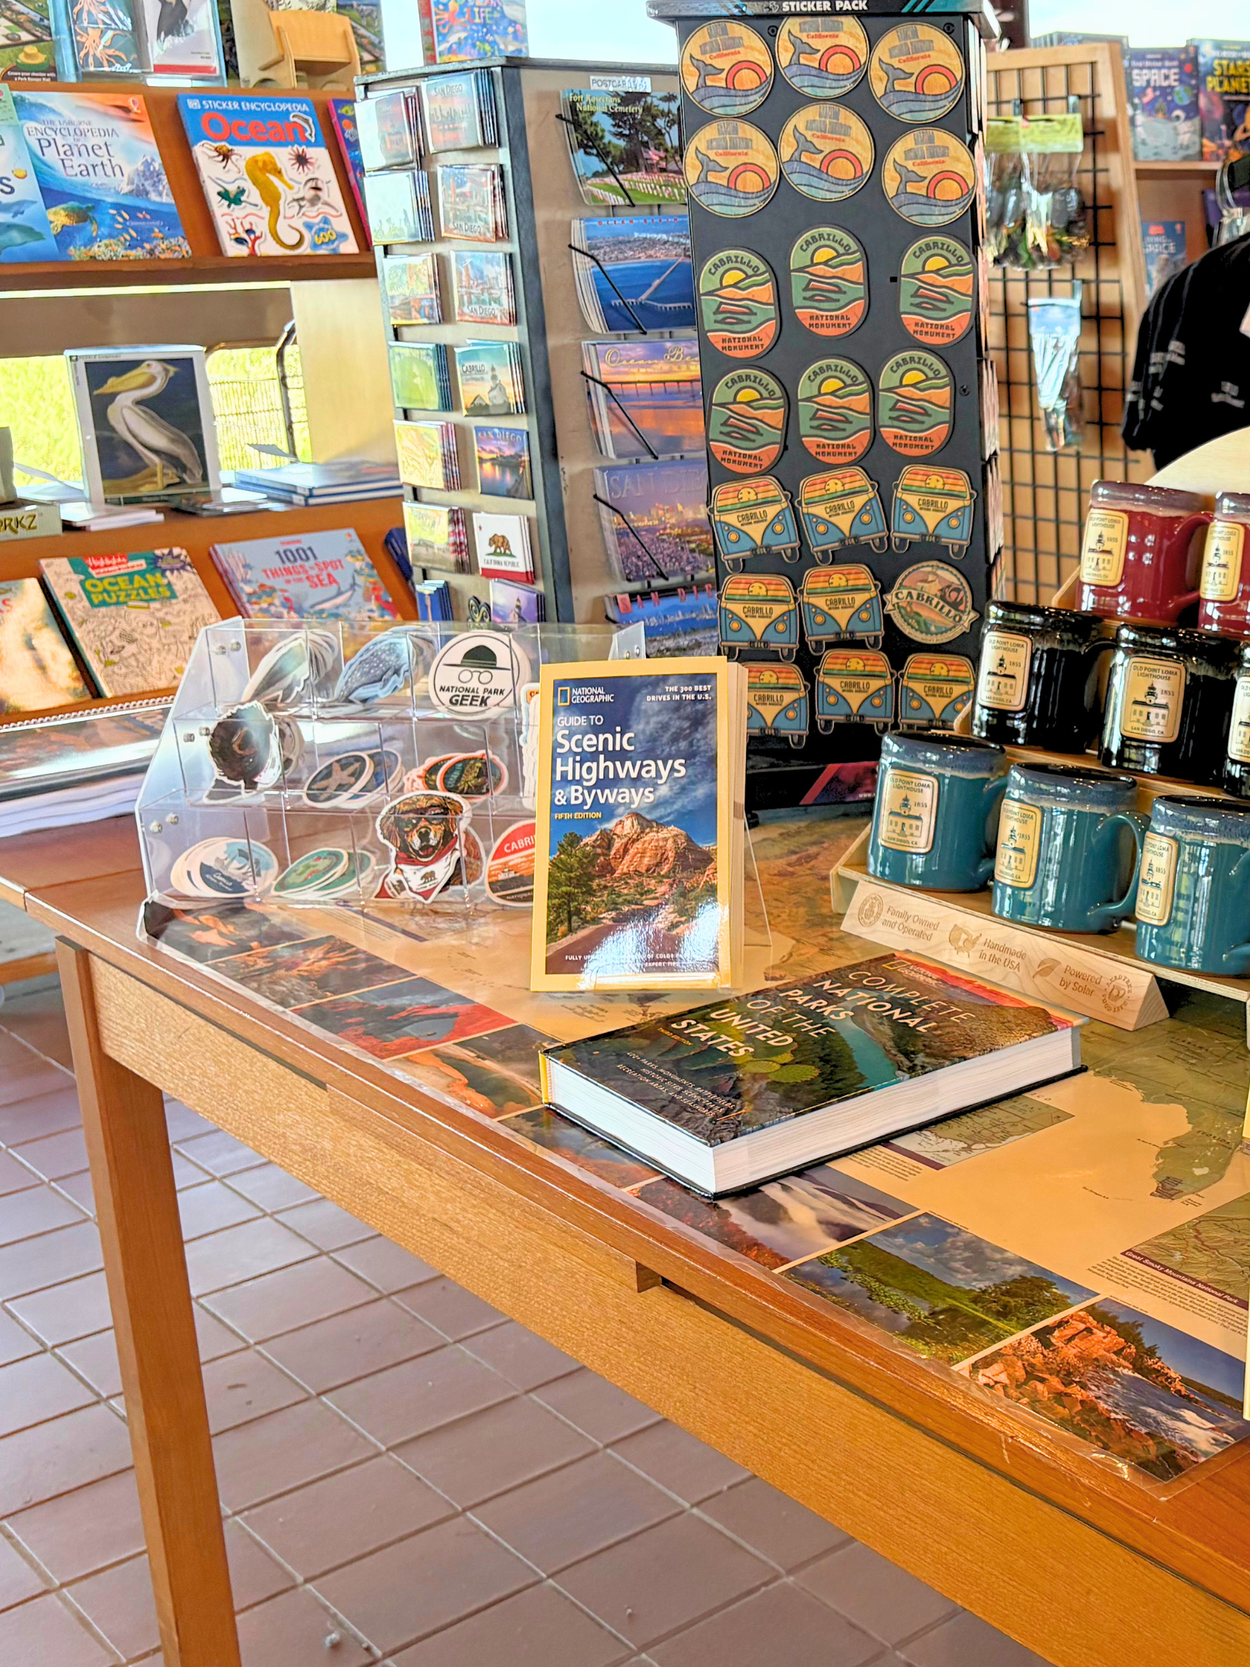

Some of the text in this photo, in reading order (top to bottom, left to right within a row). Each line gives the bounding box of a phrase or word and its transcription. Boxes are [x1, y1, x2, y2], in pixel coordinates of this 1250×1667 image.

[782, 0, 868, 12] STICKER PACK
[465, 7, 493, 24] LIFE
[709, 50, 741, 60] California
[898, 53, 931, 64] California
[1132, 68, 1180, 87] SPACE
[434, 83, 463, 97] SAN DIEGO
[569, 93, 584, 102] Fort
[202, 100, 310, 112] STICKER ENCYCLOPEDIA
[609, 104, 643, 114] Cemetery
[26, 126, 119, 138] ENCYCLOPEDIA
[201, 112, 308, 142] Ocean
[36, 138, 115, 158] Planet
[60, 158, 125, 178] Earth
[315, 230, 338, 245] 600
[800, 234, 850, 252] CABRILLO
[913, 242, 965, 263] CABRILLO
[708, 256, 760, 276] CABRILLO
[809, 323, 852, 331] MONUMENT
[913, 330, 956, 340] MONUMENT
[914, 321, 955, 332] NATIONAL
[462, 364, 486, 375] CABRILLO
[890, 356, 941, 377] CABRILLO
[725, 375, 777, 399] CABRILLO
[496, 430, 522, 443] DIEGO
[737, 510, 768, 524] CABRILLO
[275, 545, 318, 565] 1001
[262, 558, 345, 580] THINGS SPOT
[85, 573, 165, 592] OCEAN
[305, 572, 340, 589] SEA
[91, 587, 171, 605] PUZZLES
[742, 606, 774, 616] CABRILLO
[894, 590, 963, 624] CABRILLO
[1137, 671, 1171, 681] LIGHTHOUSE
[1161, 669, 1178, 677] LOMA
[439, 685, 506, 697] NATIONAL PARK
[572, 686, 606, 695] NATIONAL
[646, 694, 667, 702] DRIVES
[697, 693, 712, 701] U.S.
[680, 686, 693, 694] 300
[753, 694, 784, 703] CABRILLO
[1160, 689, 1175, 697] 1855
[448, 694, 491, 707] GEEK
[571, 694, 615, 704] GEOGRAPHIC
[557, 715, 604, 727] GUIDE TO
[556, 726, 635, 754] Scenic
[555, 754, 687, 787] Highways
[893, 784, 924, 794] LIGHTHOUSE
[898, 779, 931, 789] POINT LOMA
[554, 785, 655, 810] & Byways
[554, 811, 602, 820] FIFTH EDITION
[887, 905, 941, 931] Family Owned
[881, 918, 934, 942] and Operated
[983, 938, 1027, 961] Handmade
[978, 950, 1021, 973] in the USA
[1064, 964, 1103, 986] Powered
[1058, 976, 1096, 998] by Solar
[779, 988, 856, 1022] PARKS
[848, 970, 975, 1024] COMPLETE
[813, 978, 940, 1034] NATIONAL
[746, 999, 836, 1038] OF THE
[710, 1008, 795, 1048] UNITED
[671, 1018, 756, 1059] STATES
[1125, 1250, 1239, 1304] Great Smoky Mountains National Park
